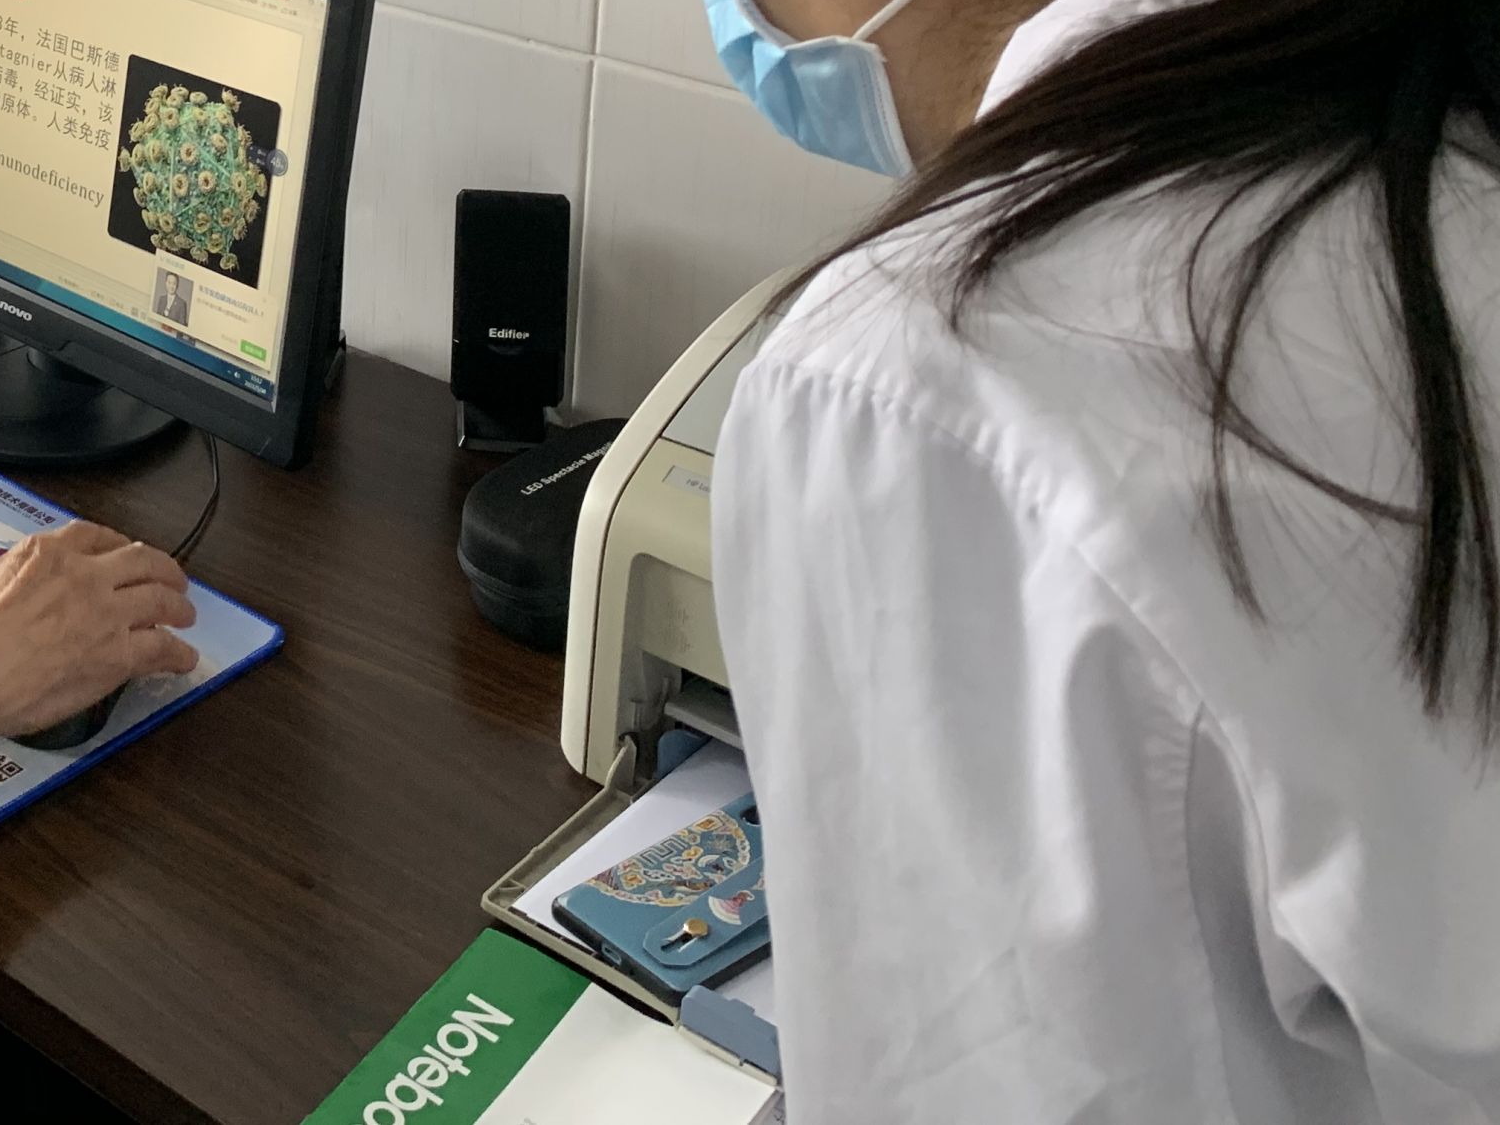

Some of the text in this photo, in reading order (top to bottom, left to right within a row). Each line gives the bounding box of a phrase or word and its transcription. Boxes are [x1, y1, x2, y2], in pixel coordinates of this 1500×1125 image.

[489, 327, 528, 339] Edifier
[521, 482, 543, 495] LED
[540, 459, 586, 485] Spectacle
